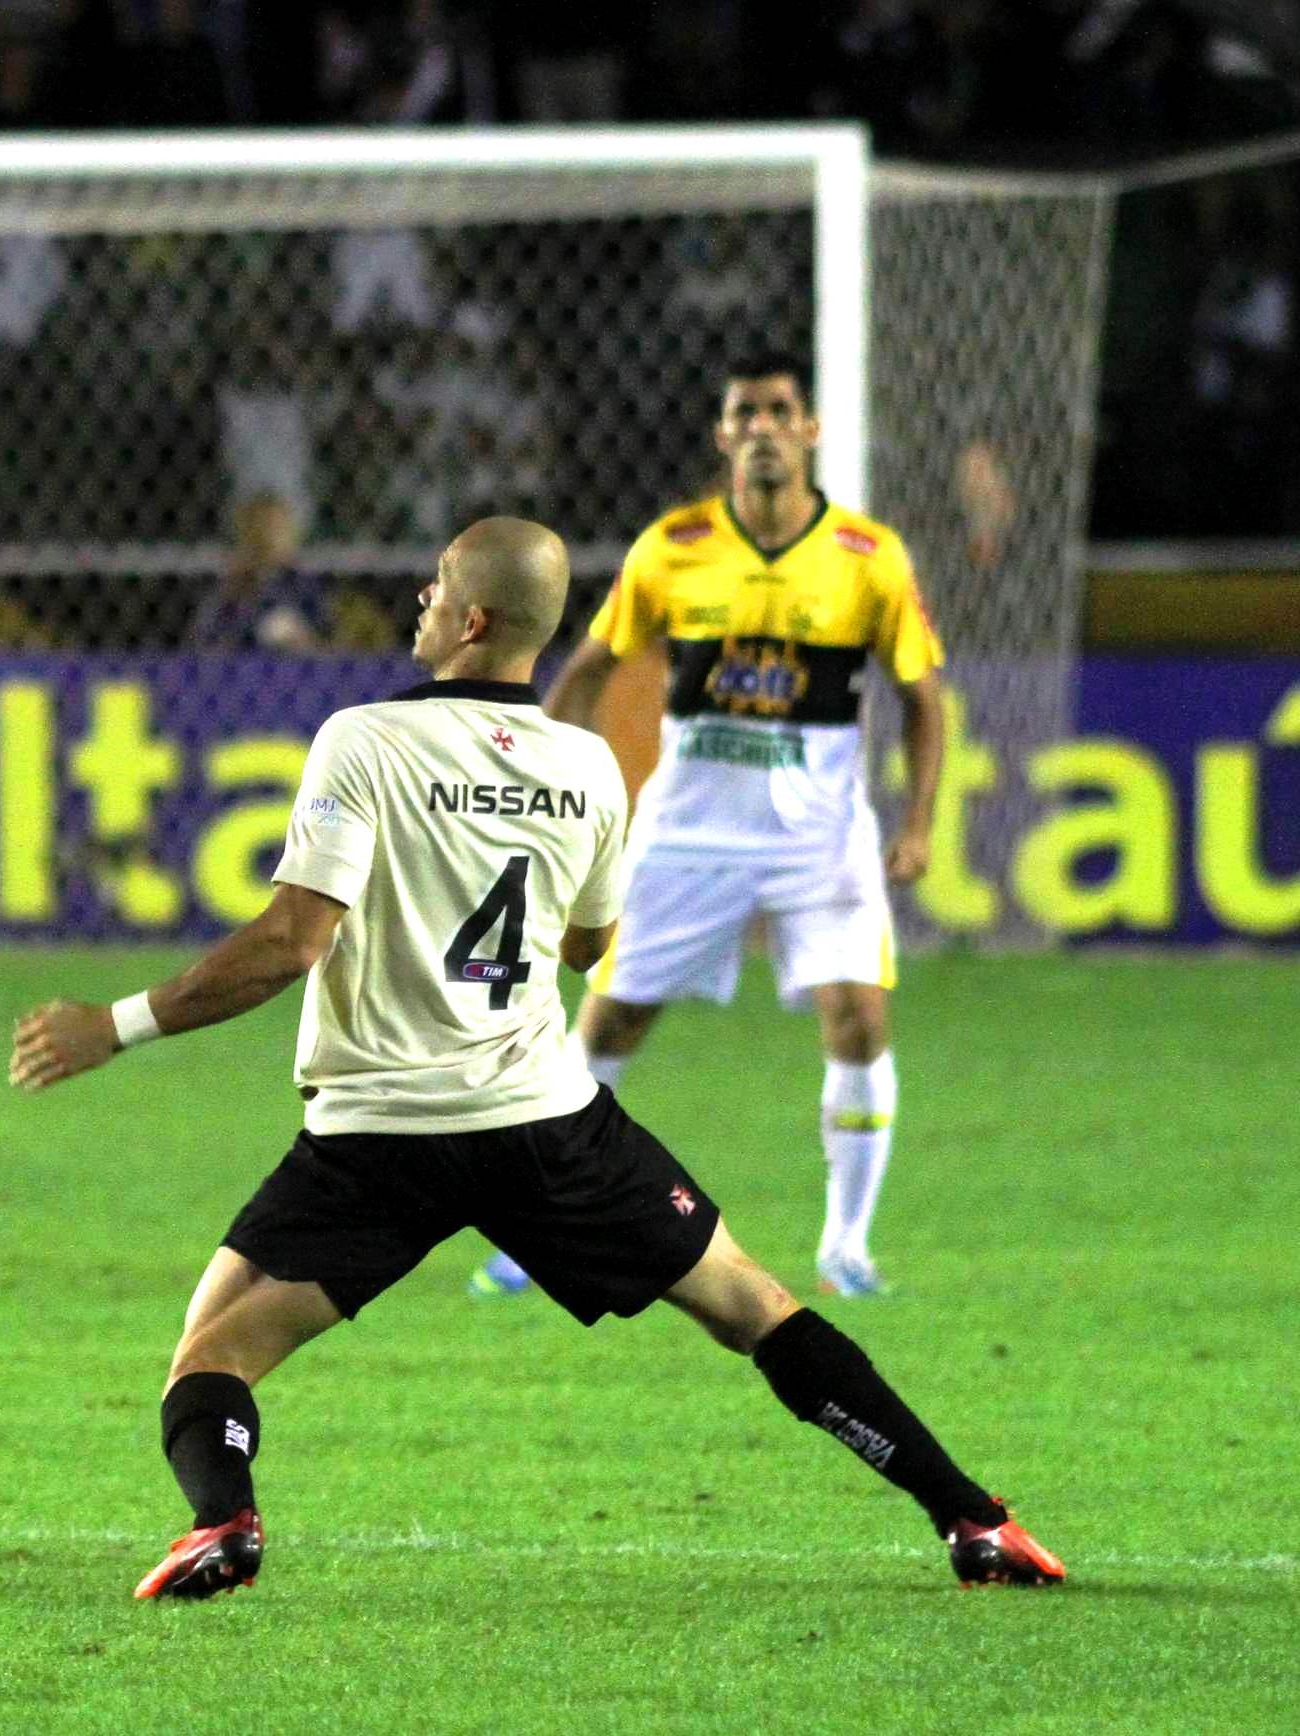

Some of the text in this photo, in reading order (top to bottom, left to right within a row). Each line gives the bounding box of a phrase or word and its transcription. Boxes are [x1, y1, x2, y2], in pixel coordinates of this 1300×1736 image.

[428, 783, 586, 819] NISSAN
[888, 682, 1300, 937] taú
[444, 856, 531, 1010] 4
[482, 966, 503, 977] TIM
